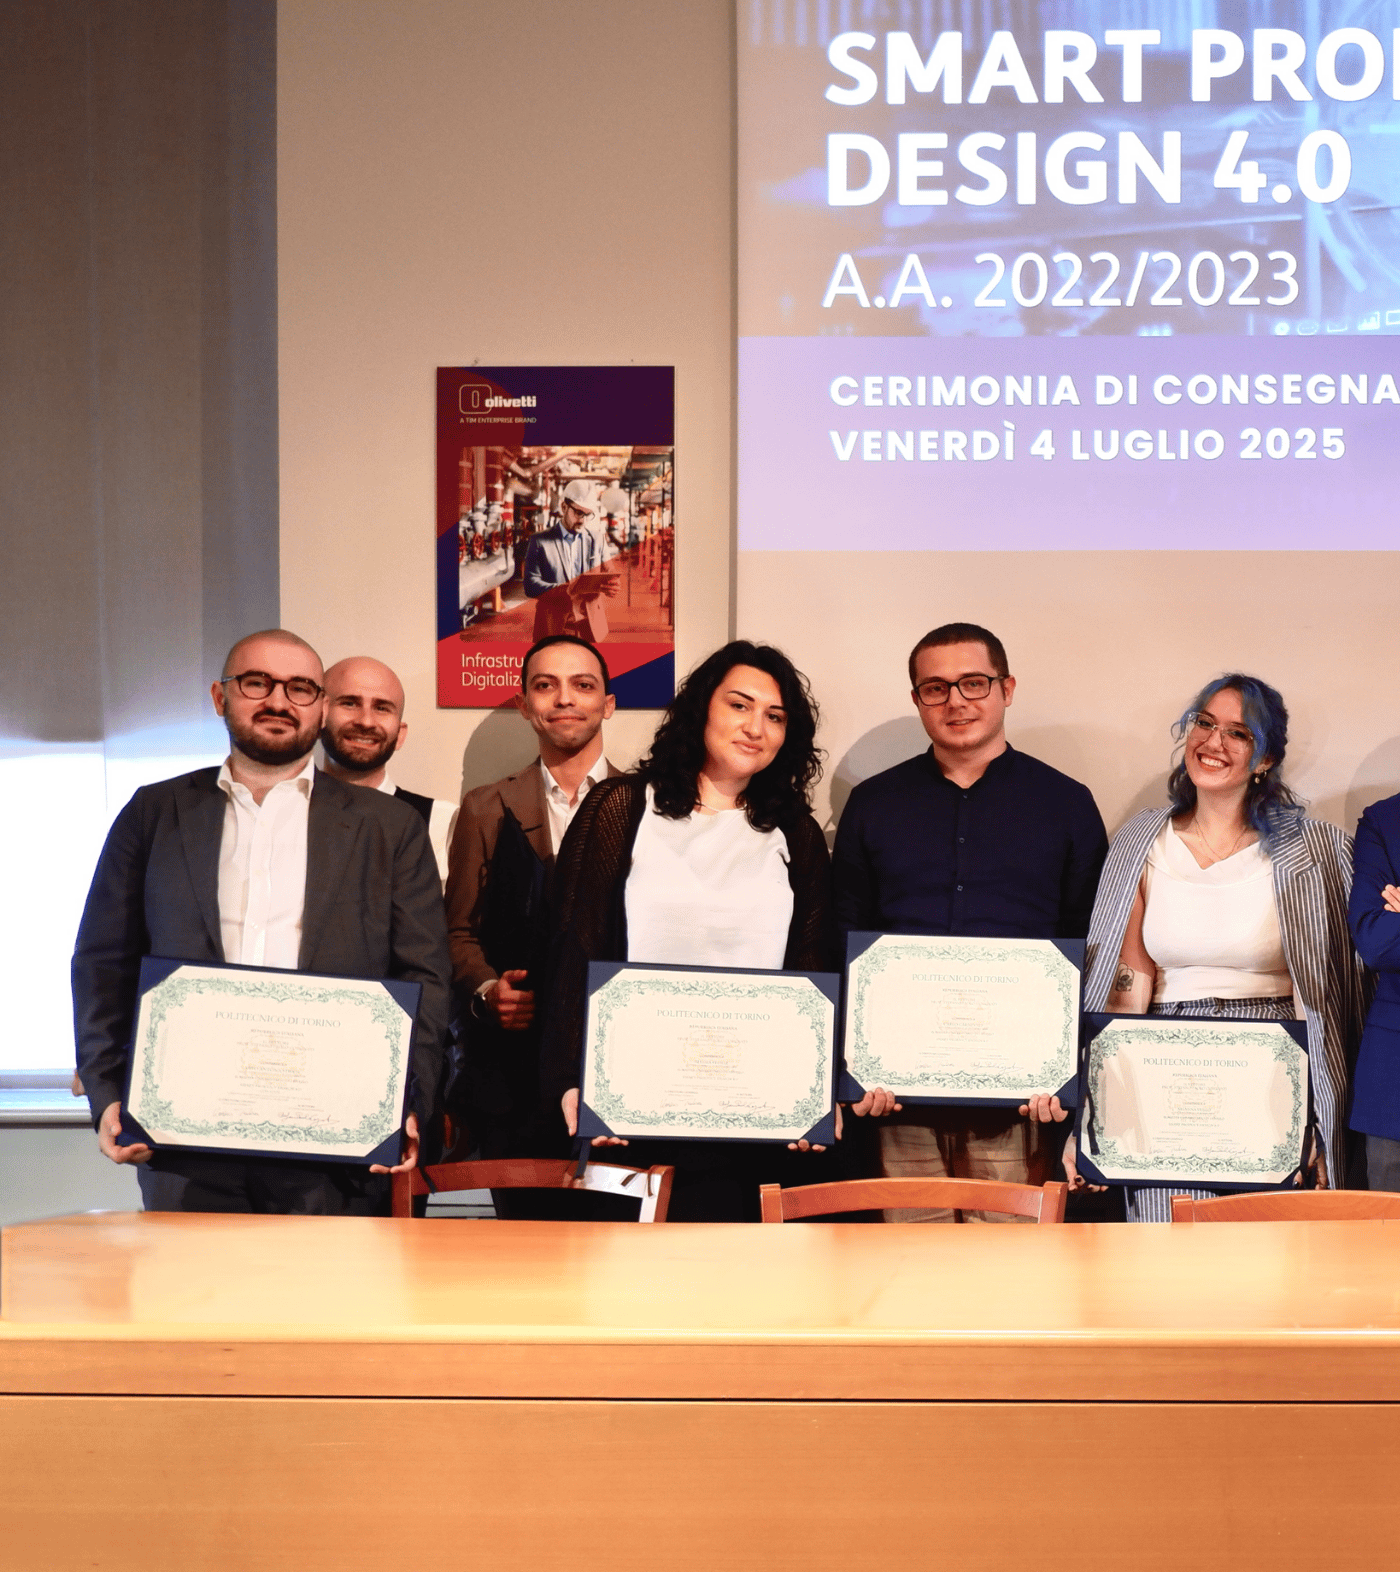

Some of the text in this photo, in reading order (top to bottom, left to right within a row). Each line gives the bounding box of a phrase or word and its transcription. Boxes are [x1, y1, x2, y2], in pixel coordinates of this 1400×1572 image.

[824, 30, 1161, 105] SMART
[826, 129, 1352, 207] DESIGN 4.0
[821, 252, 1299, 309] A.A. 2022/2023
[830, 375, 1081, 407] CERIMONIA
[1096, 375, 1139, 405] DI
[485, 395, 536, 408] olivetti
[829, 421, 1345, 462] VENERDÌ 4 LUGLIO 2025
[462, 652, 524, 668] Infrastru
[462, 671, 522, 690] Digitaliz
[912, 974, 971, 982] POLITECNICO
[985, 976, 1019, 984] TORINO
[215, 1011, 341, 1028] POLITECNICO DI TORINO
[657, 1009, 720, 1019] POLITECNICO
[734, 1013, 770, 1021] TORINO
[1143, 1058, 1201, 1066] POLITECNICO
[1214, 1060, 1248, 1068] TORINO
